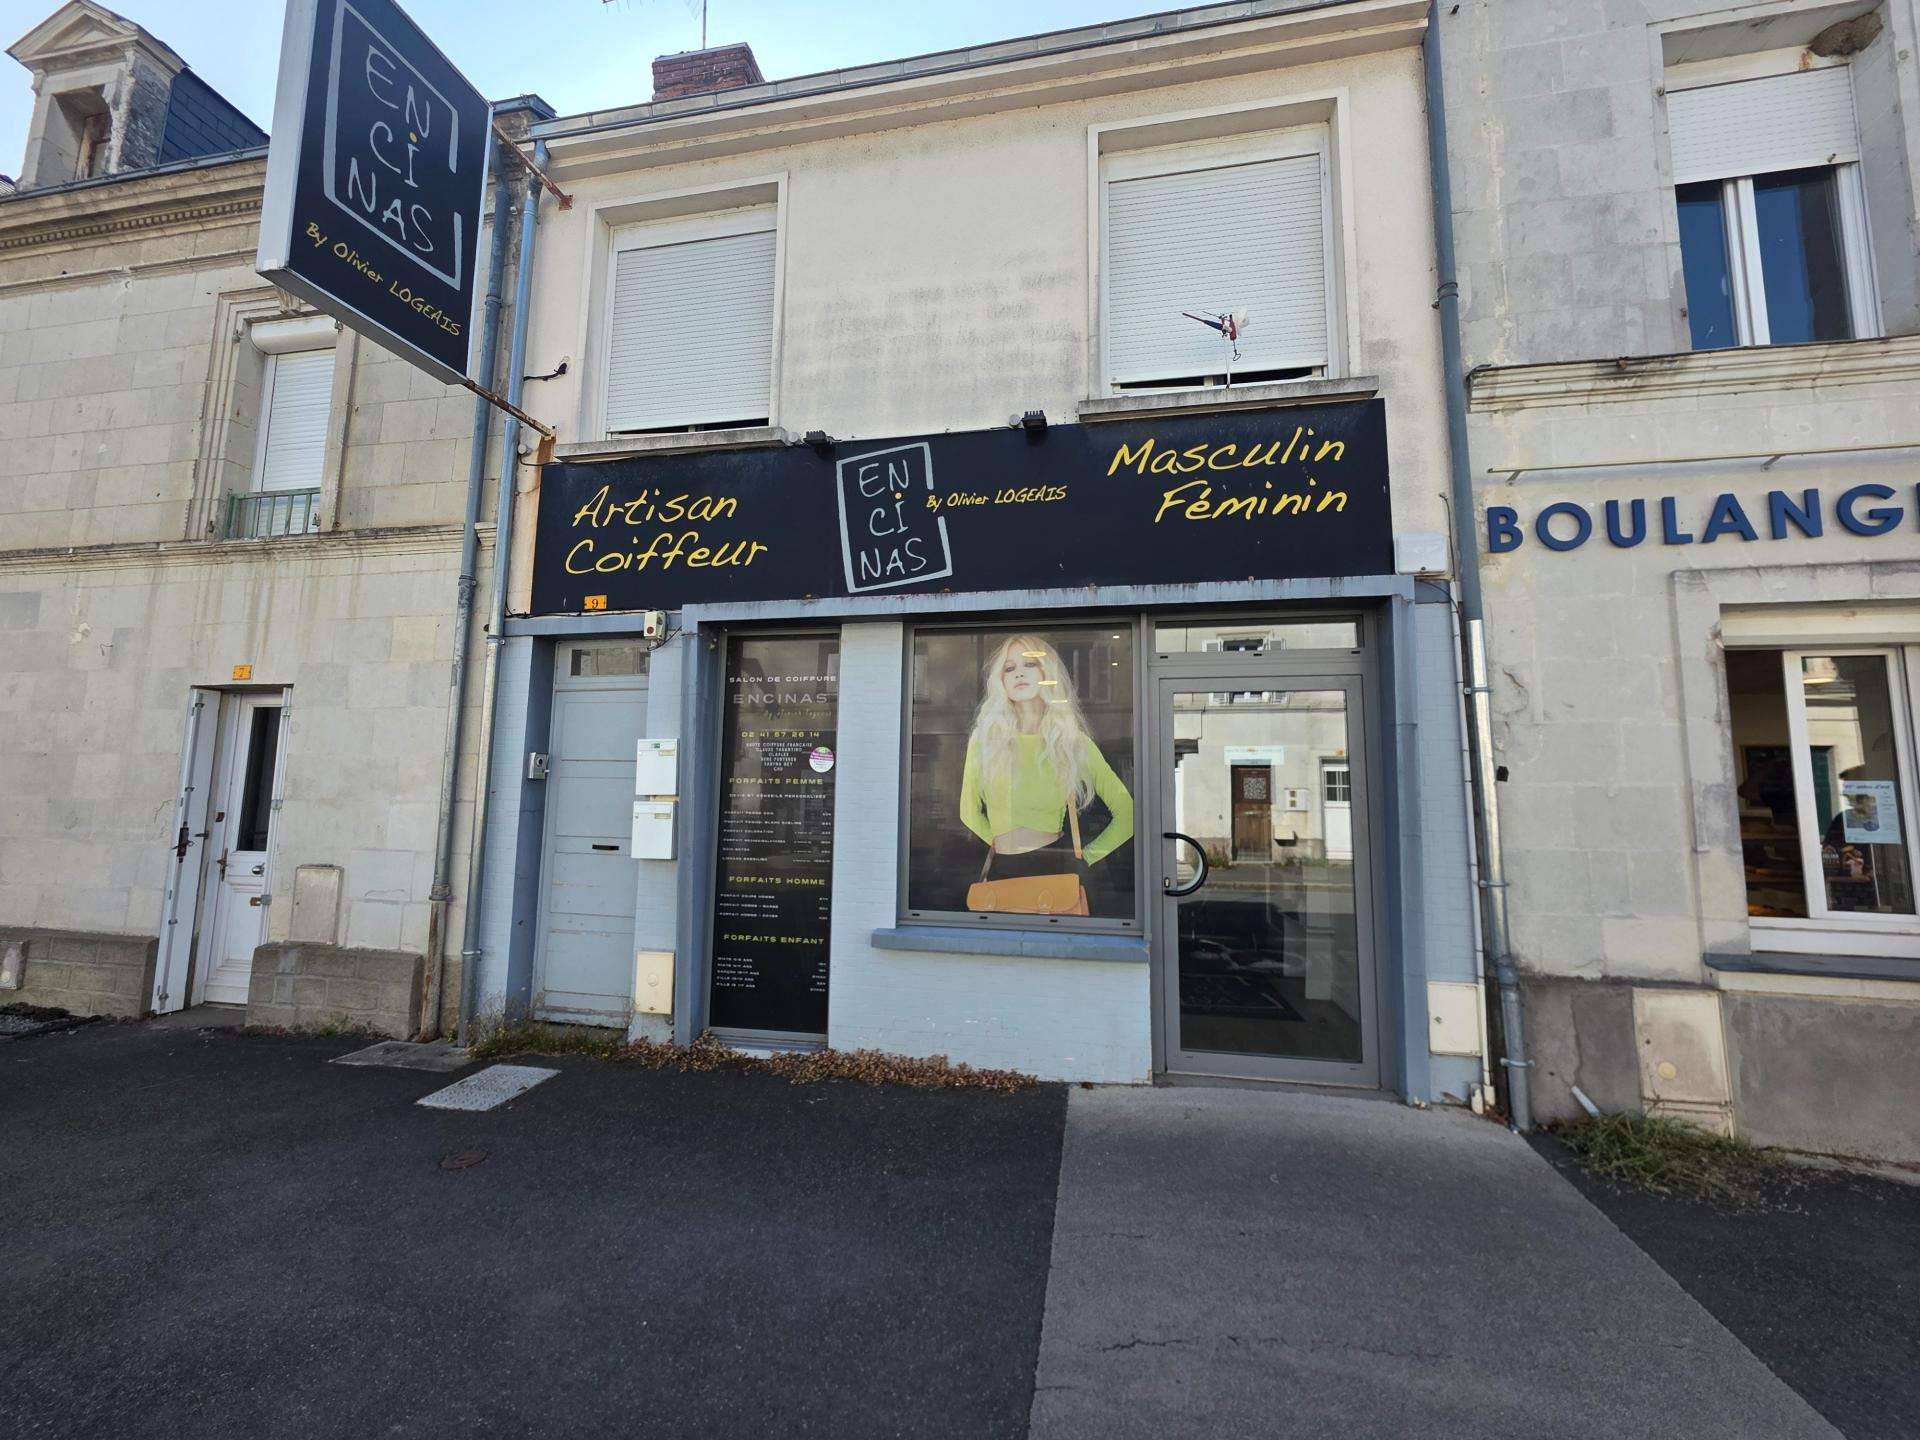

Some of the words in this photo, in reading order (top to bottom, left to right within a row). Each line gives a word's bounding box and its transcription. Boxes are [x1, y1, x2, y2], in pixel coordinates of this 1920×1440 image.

[305, 221, 328, 249] By
[333, 242, 384, 288] Olivier
[389, 280, 461, 337] LOGEAIS
[1106, 426, 1346, 477] Masculin
[572, 484, 738, 529] Artisan
[926, 494, 943, 513] By
[946, 491, 990, 507] Olivier
[994, 484, 1068, 505] LOGEAIS
[1154, 478, 1348, 524] Féminin
[1486, 482, 1920, 554] BOULANG
[565, 530, 769, 576] Coiffeur
[859, 537, 929, 581] NAS
[591, 598, 599, 609] 9
[729, 676, 763, 684] SALON
[785, 675, 837, 683] COIFFURE
[733, 692, 829, 705] ENCINAS
[729, 777, 781, 785] FORFAITS
[729, 876, 782, 884] FORFAITS
[786, 878, 826, 886] HOMME
[723, 934, 778, 943] FORFAITS
[780, 936, 825, 945] ENFANT
